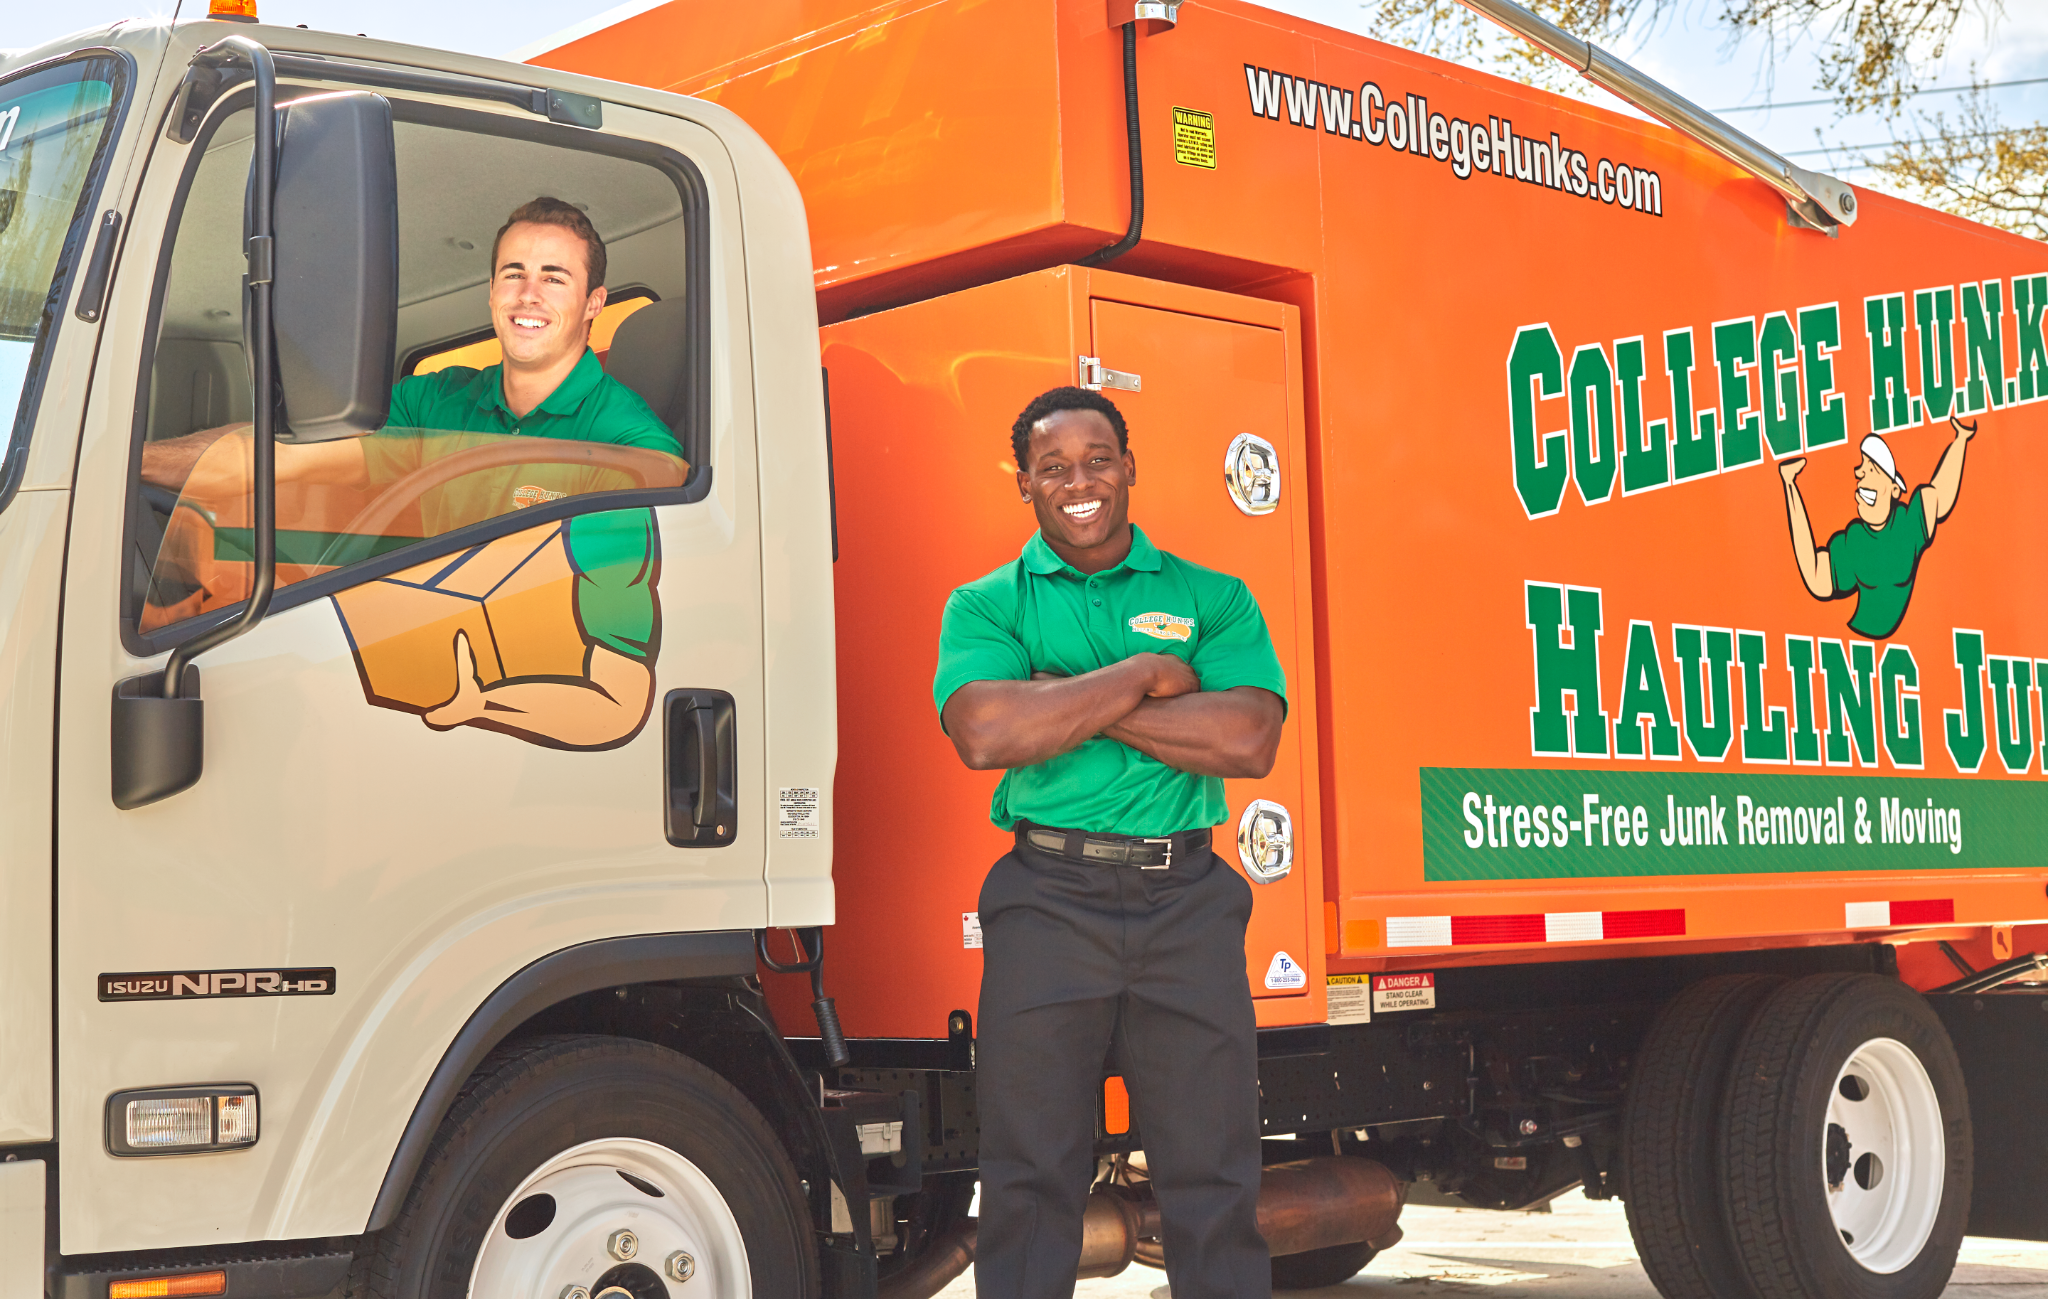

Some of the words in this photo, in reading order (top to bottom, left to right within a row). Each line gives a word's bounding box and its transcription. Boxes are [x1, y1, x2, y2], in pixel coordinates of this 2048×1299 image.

[1176, 111, 1211, 129] WARNING
[1244, 63, 1663, 217] www.CollegeHunks.com
[1506, 301, 1848, 520] COLLEGE
[1128, 615, 1164, 627] COLLEGE
[1524, 579, 1925, 770] HAULING
[1462, 792, 1649, 850] Stress-Free
[1659, 795, 1729, 847] Junk
[1737, 795, 1846, 846] Removal
[1854, 797, 1873, 844] &
[1880, 797, 1962, 854] Moving
[107, 980, 168, 994] ISUZU
[172, 972, 281, 996] NPR
[282, 980, 328, 992] HD
[1330, 976, 1356, 985] CAUTION
[1387, 976, 1420, 988] DANGER
[1380, 1000, 1397, 1009] WHILE
[1398, 998, 1429, 1008] OPERATING
[1386, 991, 1404, 1000] STAND
[1405, 990, 1423, 998] CLEAR
